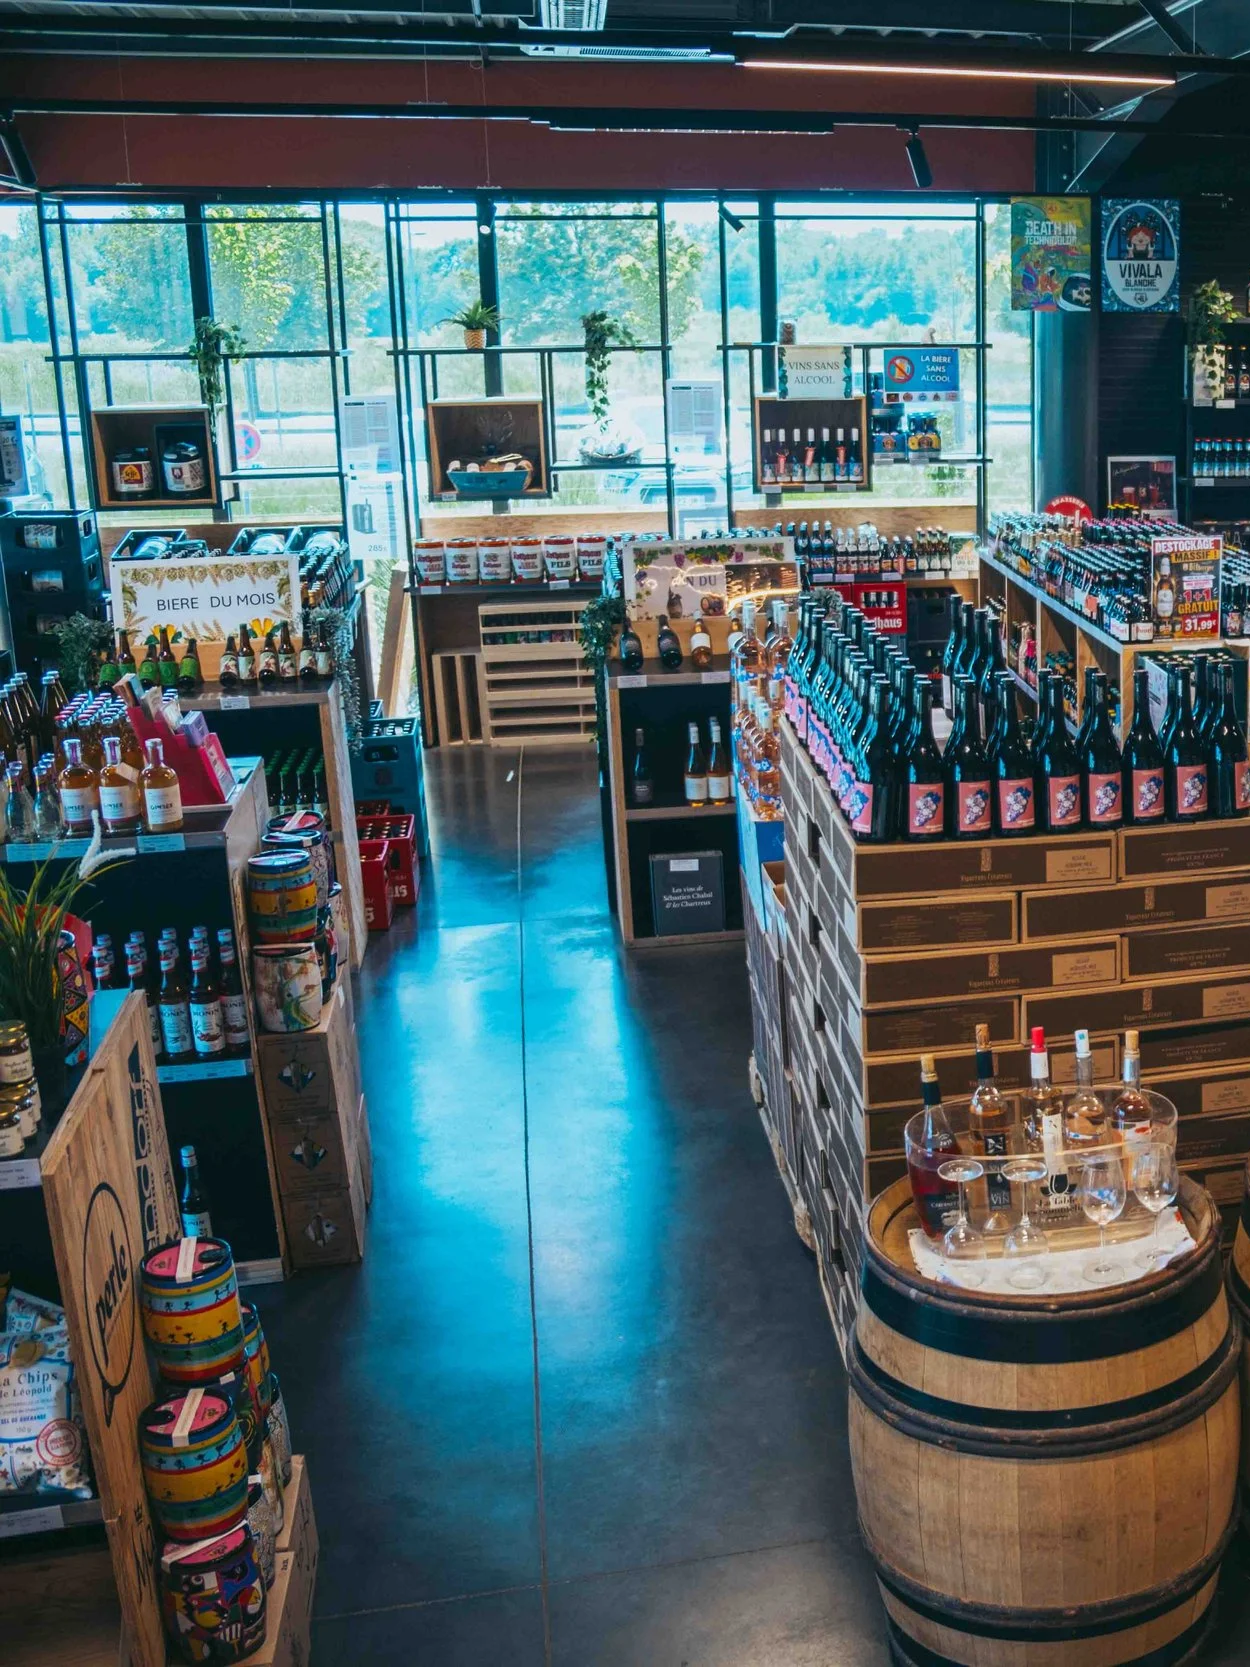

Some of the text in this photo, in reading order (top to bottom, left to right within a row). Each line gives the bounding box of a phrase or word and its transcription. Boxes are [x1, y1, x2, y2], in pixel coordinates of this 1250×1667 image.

[1025, 221, 1076, 235] DEATH IN
[788, 361, 840, 370] VINS SANS
[926, 365, 946, 373] SANS
[794, 375, 835, 385] ALCOOL
[1154, 540, 1215, 553] DESTOCKAGE
[1175, 551, 1211, 561] MASSIF
[699, 575, 716, 586] DU
[157, 593, 275, 611] BIERE DU MOIS
[1178, 600, 1218, 614] GRATUIT
[18, 1371, 58, 1385] Chips
[13, 1384, 52, 1397] Léopold
